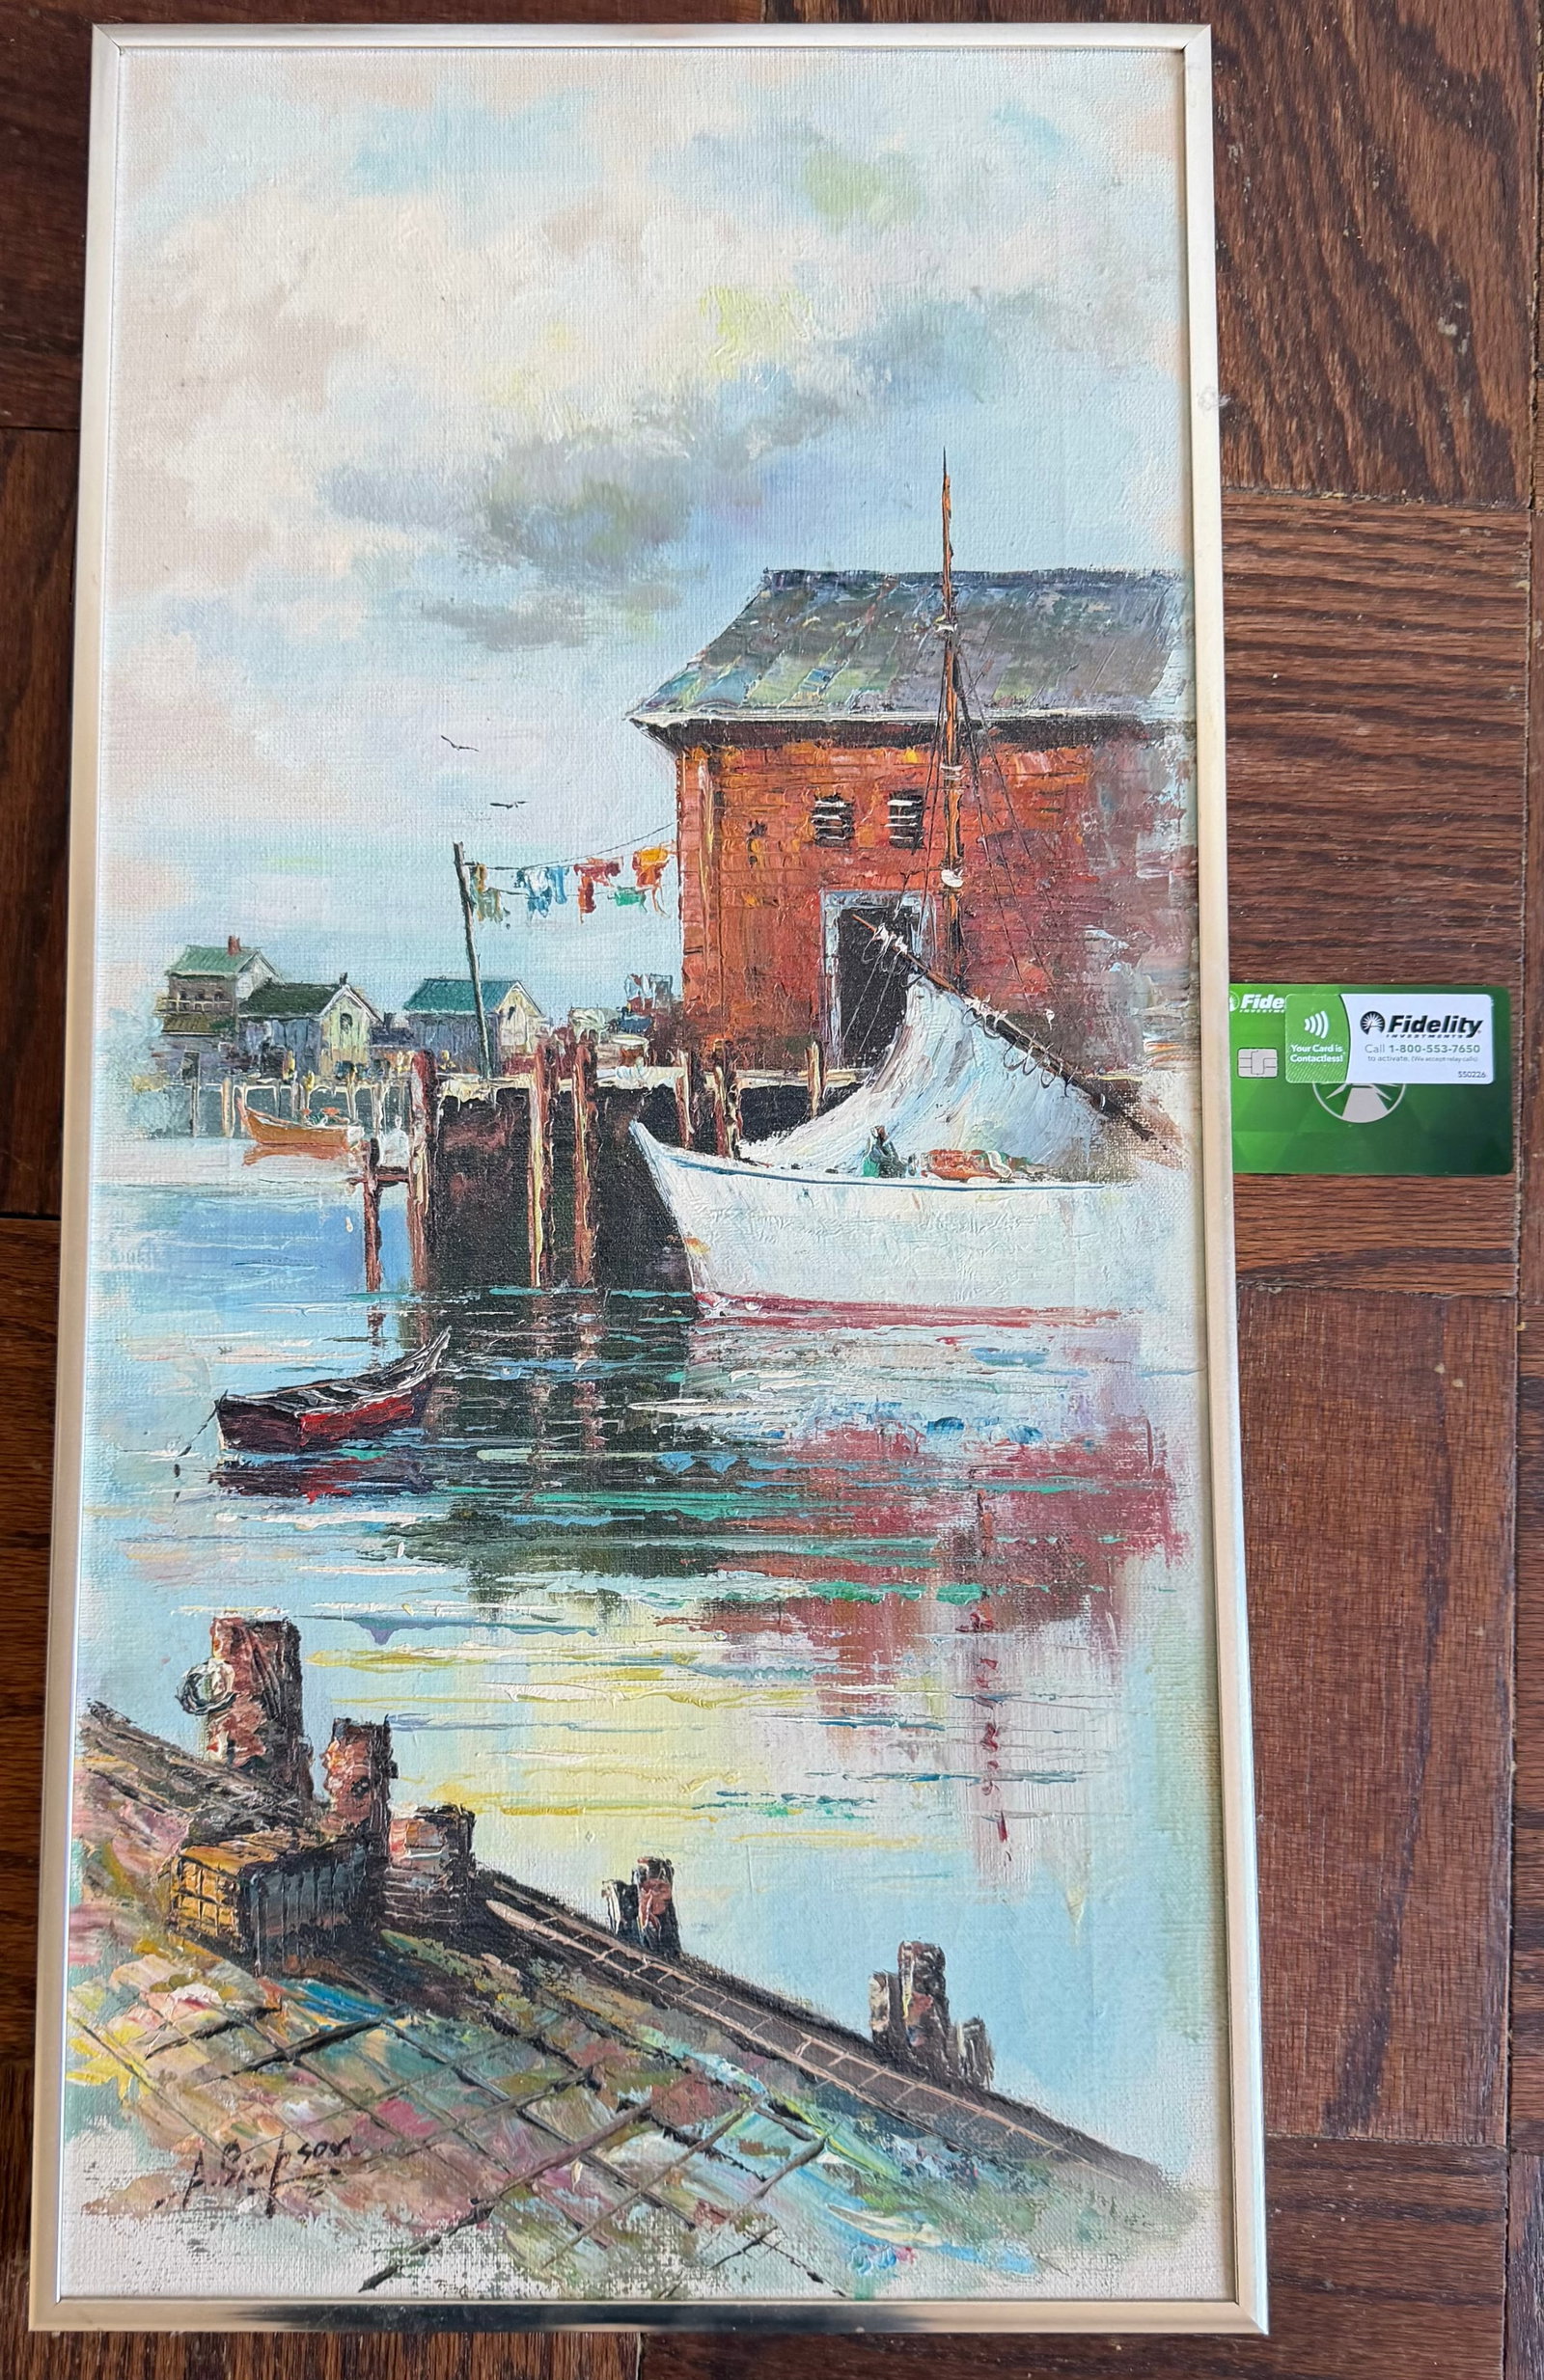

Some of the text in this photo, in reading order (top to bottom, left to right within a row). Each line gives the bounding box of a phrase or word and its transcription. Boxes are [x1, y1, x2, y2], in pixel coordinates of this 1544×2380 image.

[1388, 1015, 1483, 1038] Fidelity
[1290, 1044, 1343, 1053] Your Card is
[1365, 1044, 1480, 1053] Call 1-800-553-7650
[1289, 1053, 1343, 1062] Contactless!
